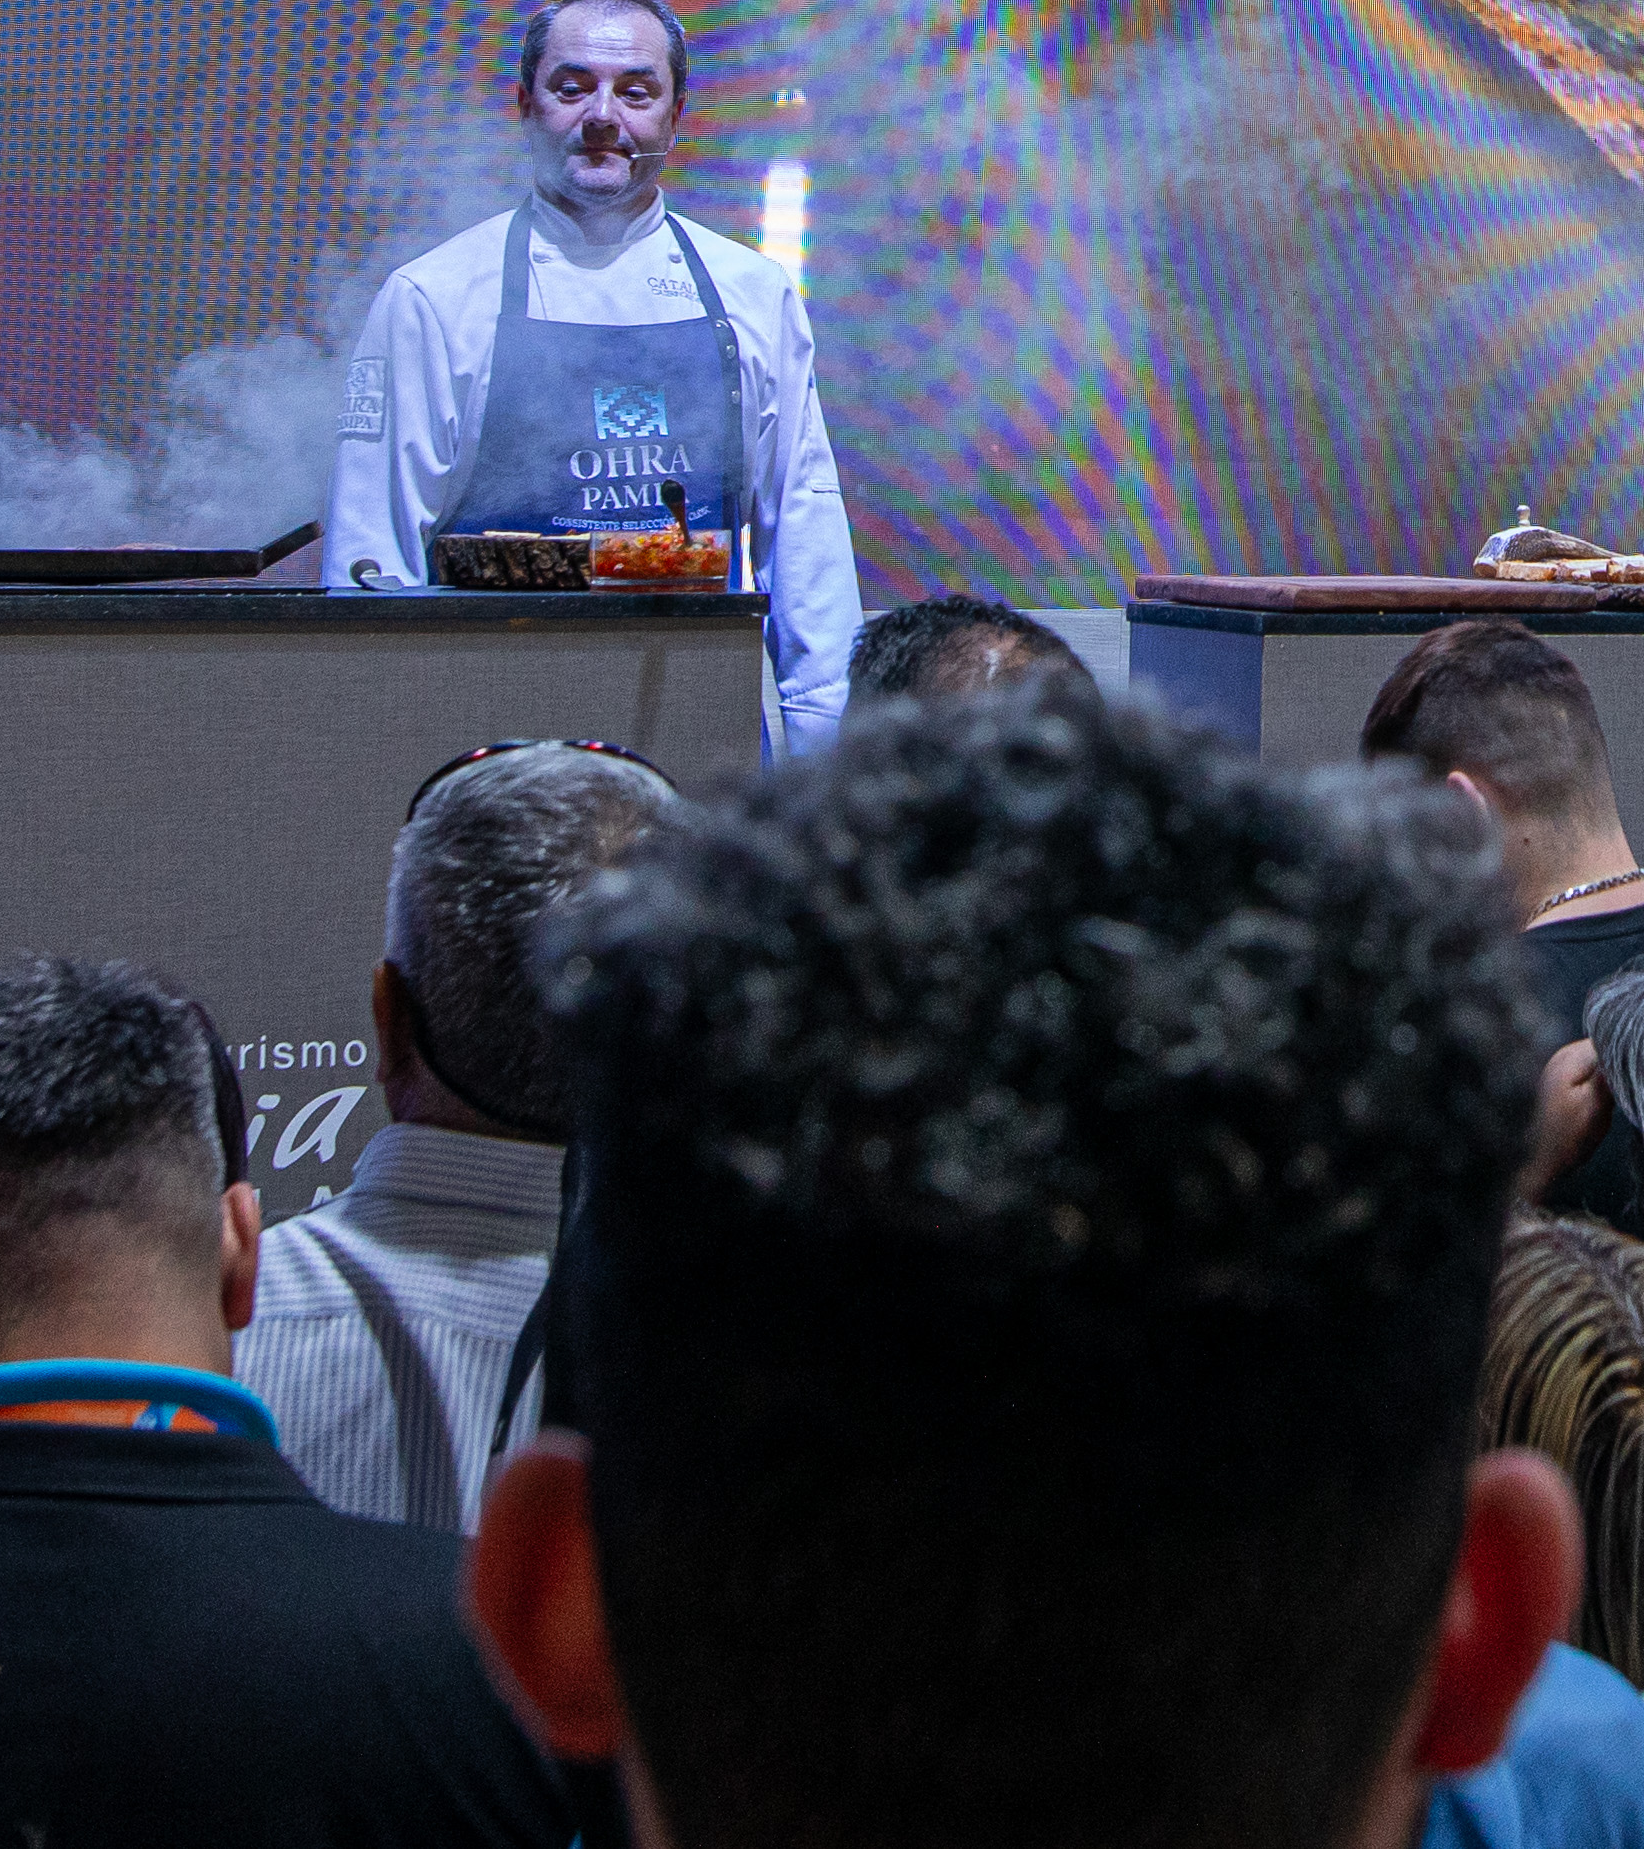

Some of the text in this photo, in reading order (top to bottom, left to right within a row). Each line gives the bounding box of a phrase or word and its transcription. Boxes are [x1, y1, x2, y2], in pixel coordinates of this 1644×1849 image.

[569, 443, 695, 480] OHRA
[580, 482, 691, 511] PAM
[225, 1034, 368, 1071] rismo
